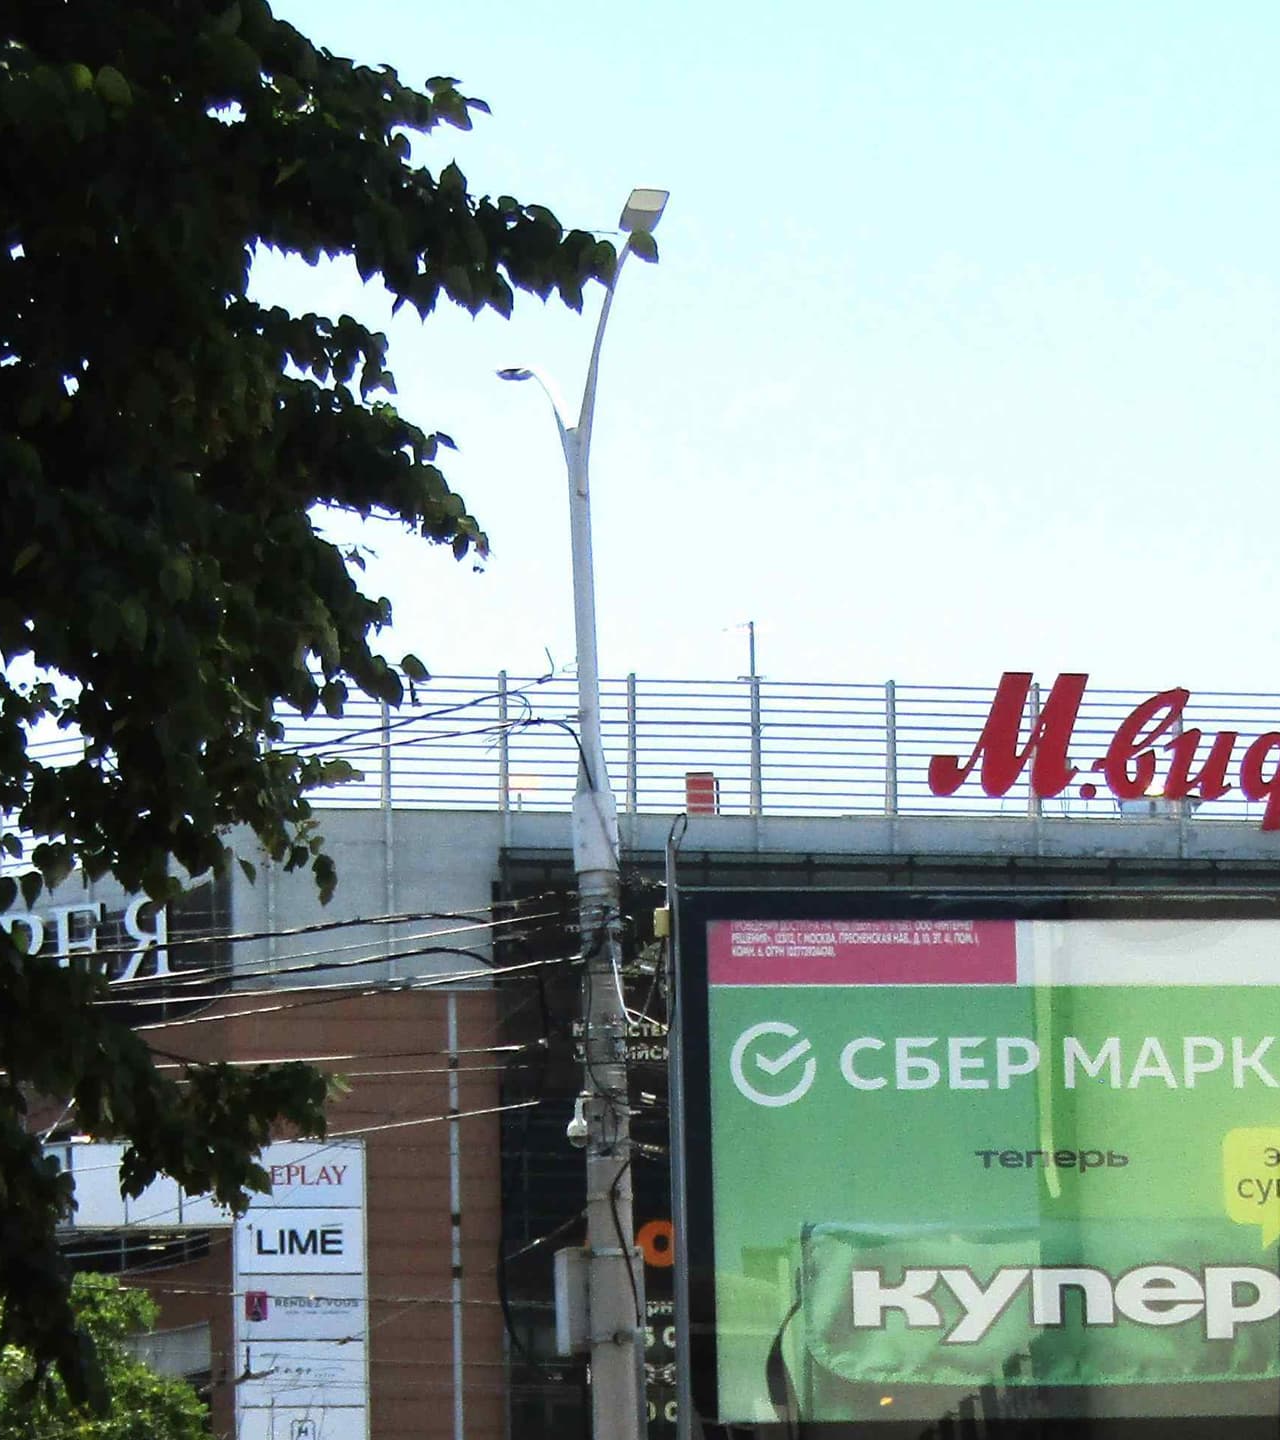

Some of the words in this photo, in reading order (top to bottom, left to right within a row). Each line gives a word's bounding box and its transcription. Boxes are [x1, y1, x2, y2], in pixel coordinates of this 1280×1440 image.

[840, 1036, 1040, 1091] СБЕР
[974, 1147, 1130, 1173] теперь
[271, 1164, 348, 1186] EPLAY
[256, 1229, 343, 1255] LIME
